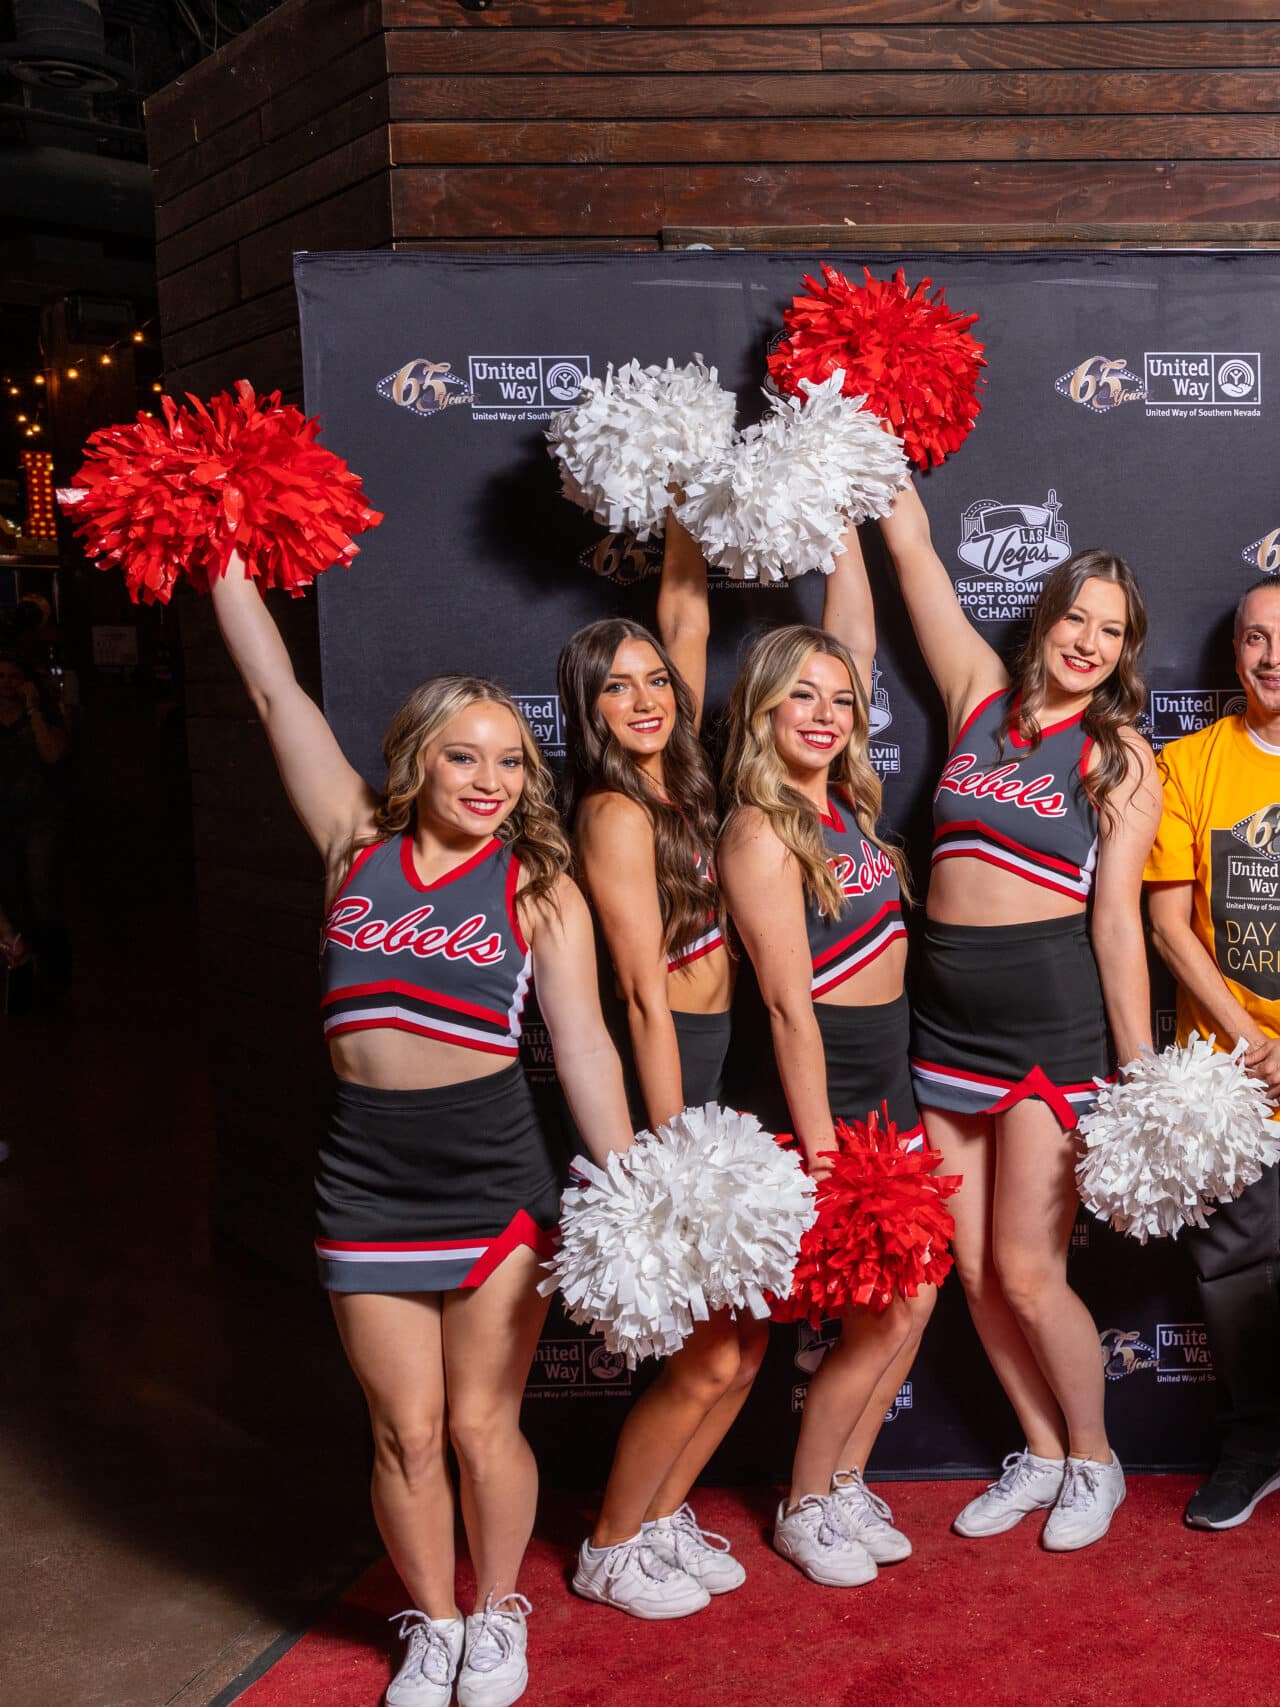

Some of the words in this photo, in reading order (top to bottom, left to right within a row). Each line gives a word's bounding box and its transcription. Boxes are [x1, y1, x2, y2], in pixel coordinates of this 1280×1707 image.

[474, 362, 537, 380] United
[1149, 359, 1209, 377] United
[392, 358, 451, 411] 65
[1070, 355, 1127, 408] 65
[1173, 378, 1209, 400] Way
[499, 382, 537, 403] Way
[472, 412, 498, 421] United
[499, 412, 517, 421] Way
[518, 412, 527, 420] of
[527, 412, 551, 421] South
[1146, 409, 1171, 417] United
[1172, 409, 1188, 419] Way
[1189, 408, 1197, 417] of
[1198, 408, 1232, 417] Southern
[1233, 408, 1261, 417] Nevada
[1021, 529, 1044, 543] LAS
[972, 530, 1059, 576] Vegas
[725, 580, 760, 589] Southern
[958, 582, 1004, 592] SUPER
[958, 595, 994, 605] HOST
[1155, 696, 1214, 713] United
[870, 748, 898, 759] LVIII
[935, 753, 1068, 817] Rebels
[1232, 861, 1279, 877] United
[1249, 878, 1279, 897] Way
[1226, 902, 1246, 910] United
[1247, 903, 1260, 911] Way
[1261, 902, 1268, 910] of
[326, 896, 507, 966] Rebels
[1226, 920, 1277, 946] DAY
[531, 1047, 553, 1063] Wa
[1160, 1329, 1207, 1346] Unite
[544, 1363, 580, 1382] Way
[1157, 1375, 1180, 1383] United
[1182, 1375, 1197, 1383] Way
